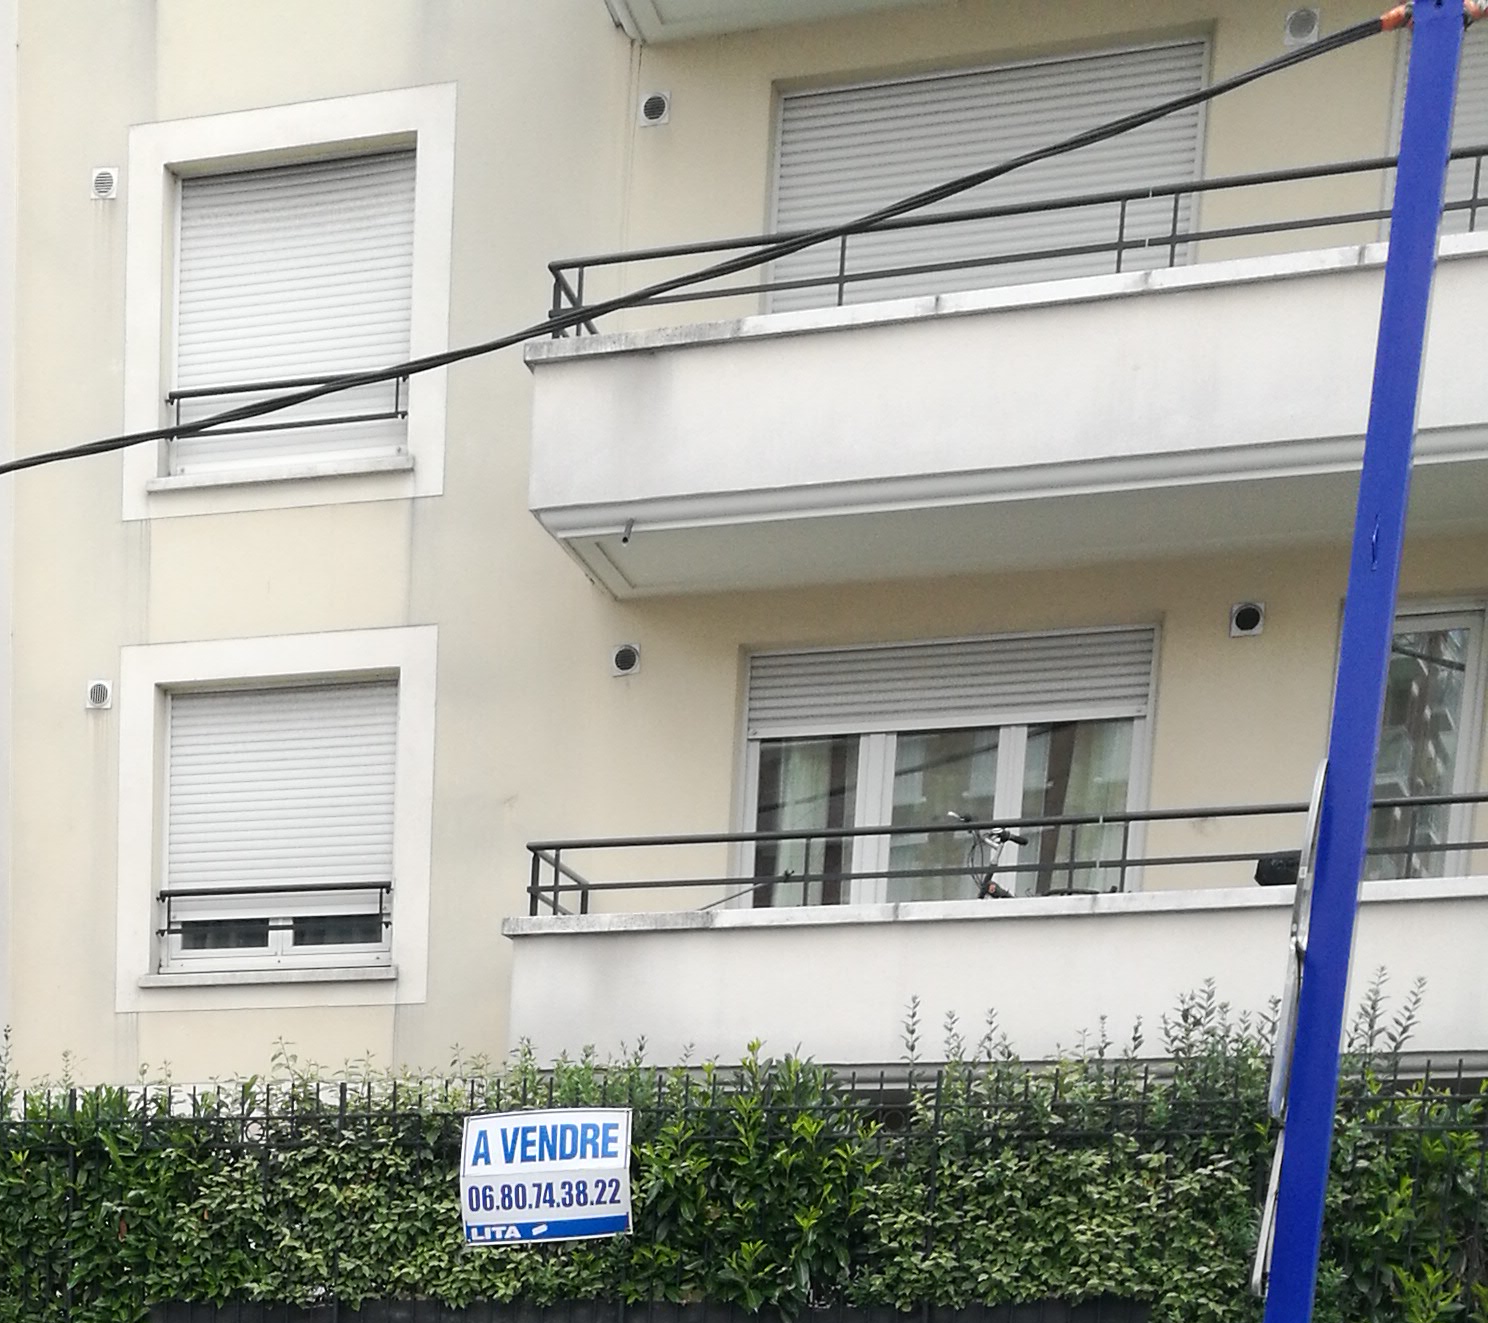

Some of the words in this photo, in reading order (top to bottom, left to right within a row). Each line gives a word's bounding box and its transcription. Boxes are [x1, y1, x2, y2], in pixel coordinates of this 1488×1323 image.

[471, 1129, 492, 1167] A
[500, 1122, 620, 1165] VENDRE
[467, 1177, 622, 1213] 06.80.74.38.22
[470, 1225, 522, 1241] LITA
